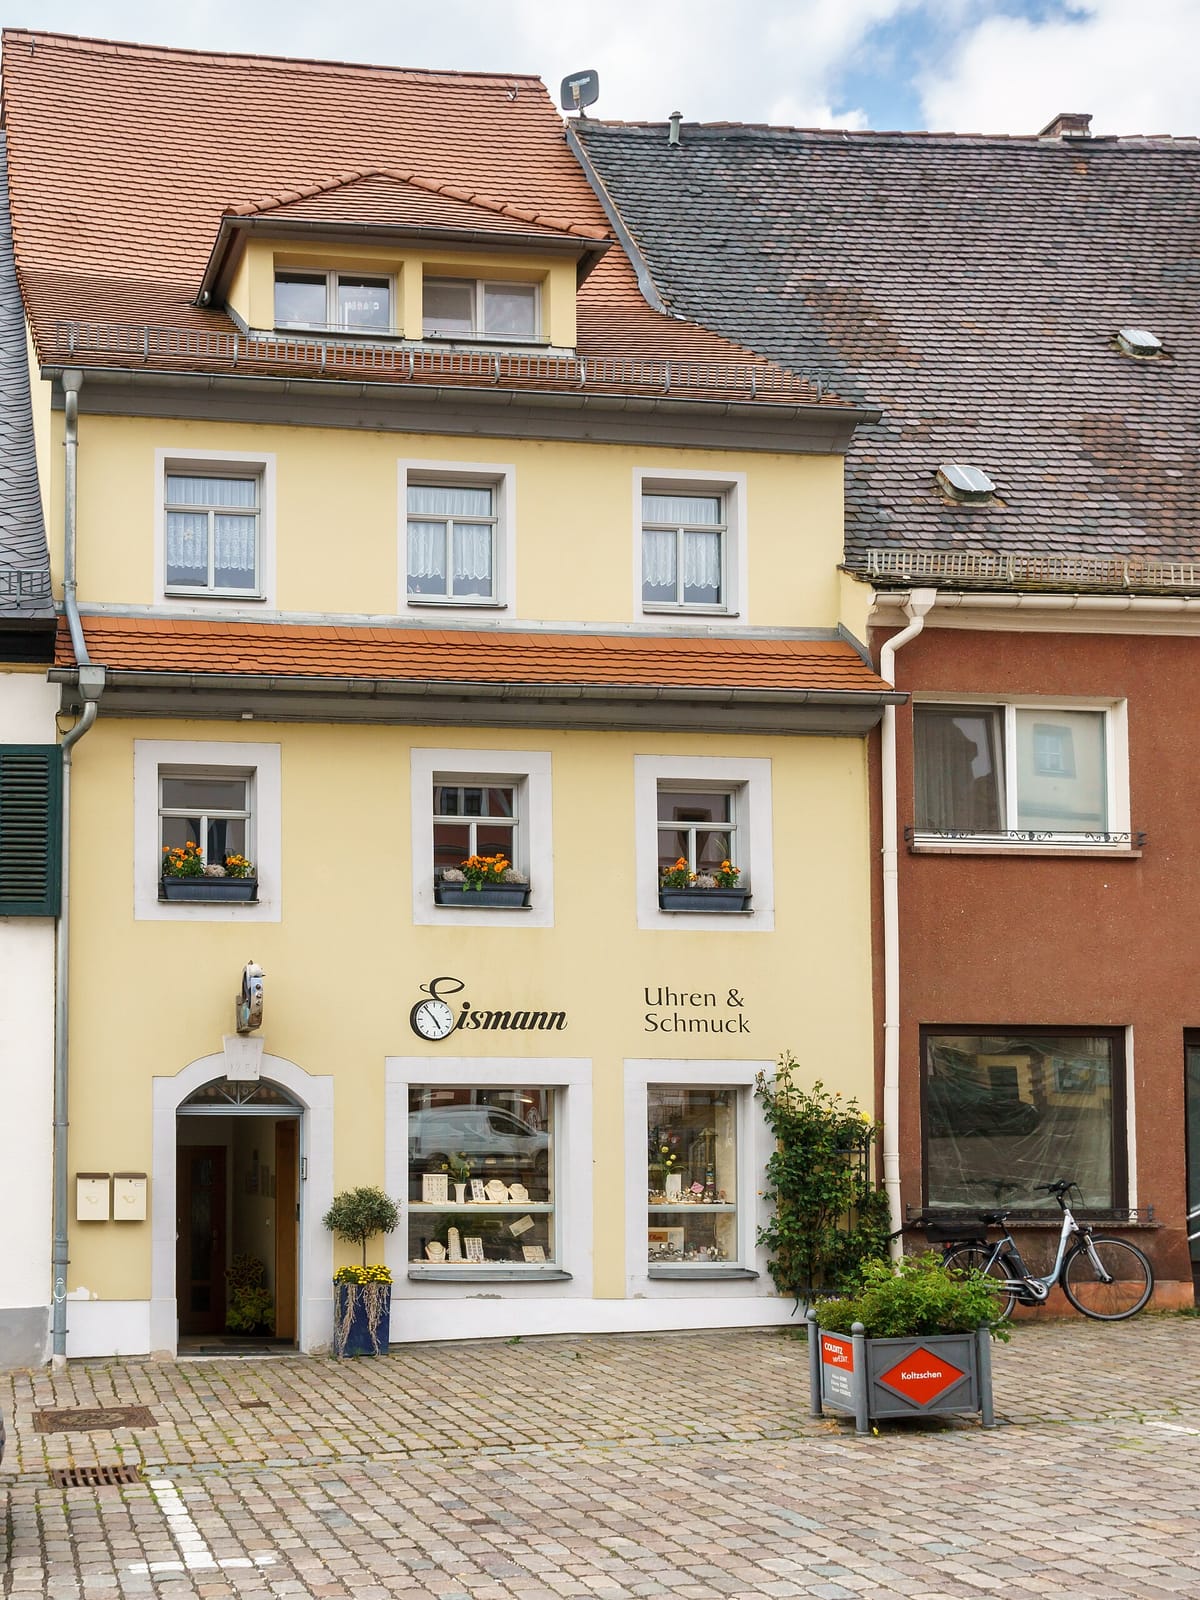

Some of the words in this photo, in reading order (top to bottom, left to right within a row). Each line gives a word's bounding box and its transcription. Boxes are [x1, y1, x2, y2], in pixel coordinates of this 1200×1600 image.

[644, 986, 717, 1007] Uhren
[726, 987, 745, 1007] &
[409, 976, 568, 1041] Eismann
[644, 1011, 751, 1034] Schmuck
[901, 1370, 942, 1380] Koltzschen
